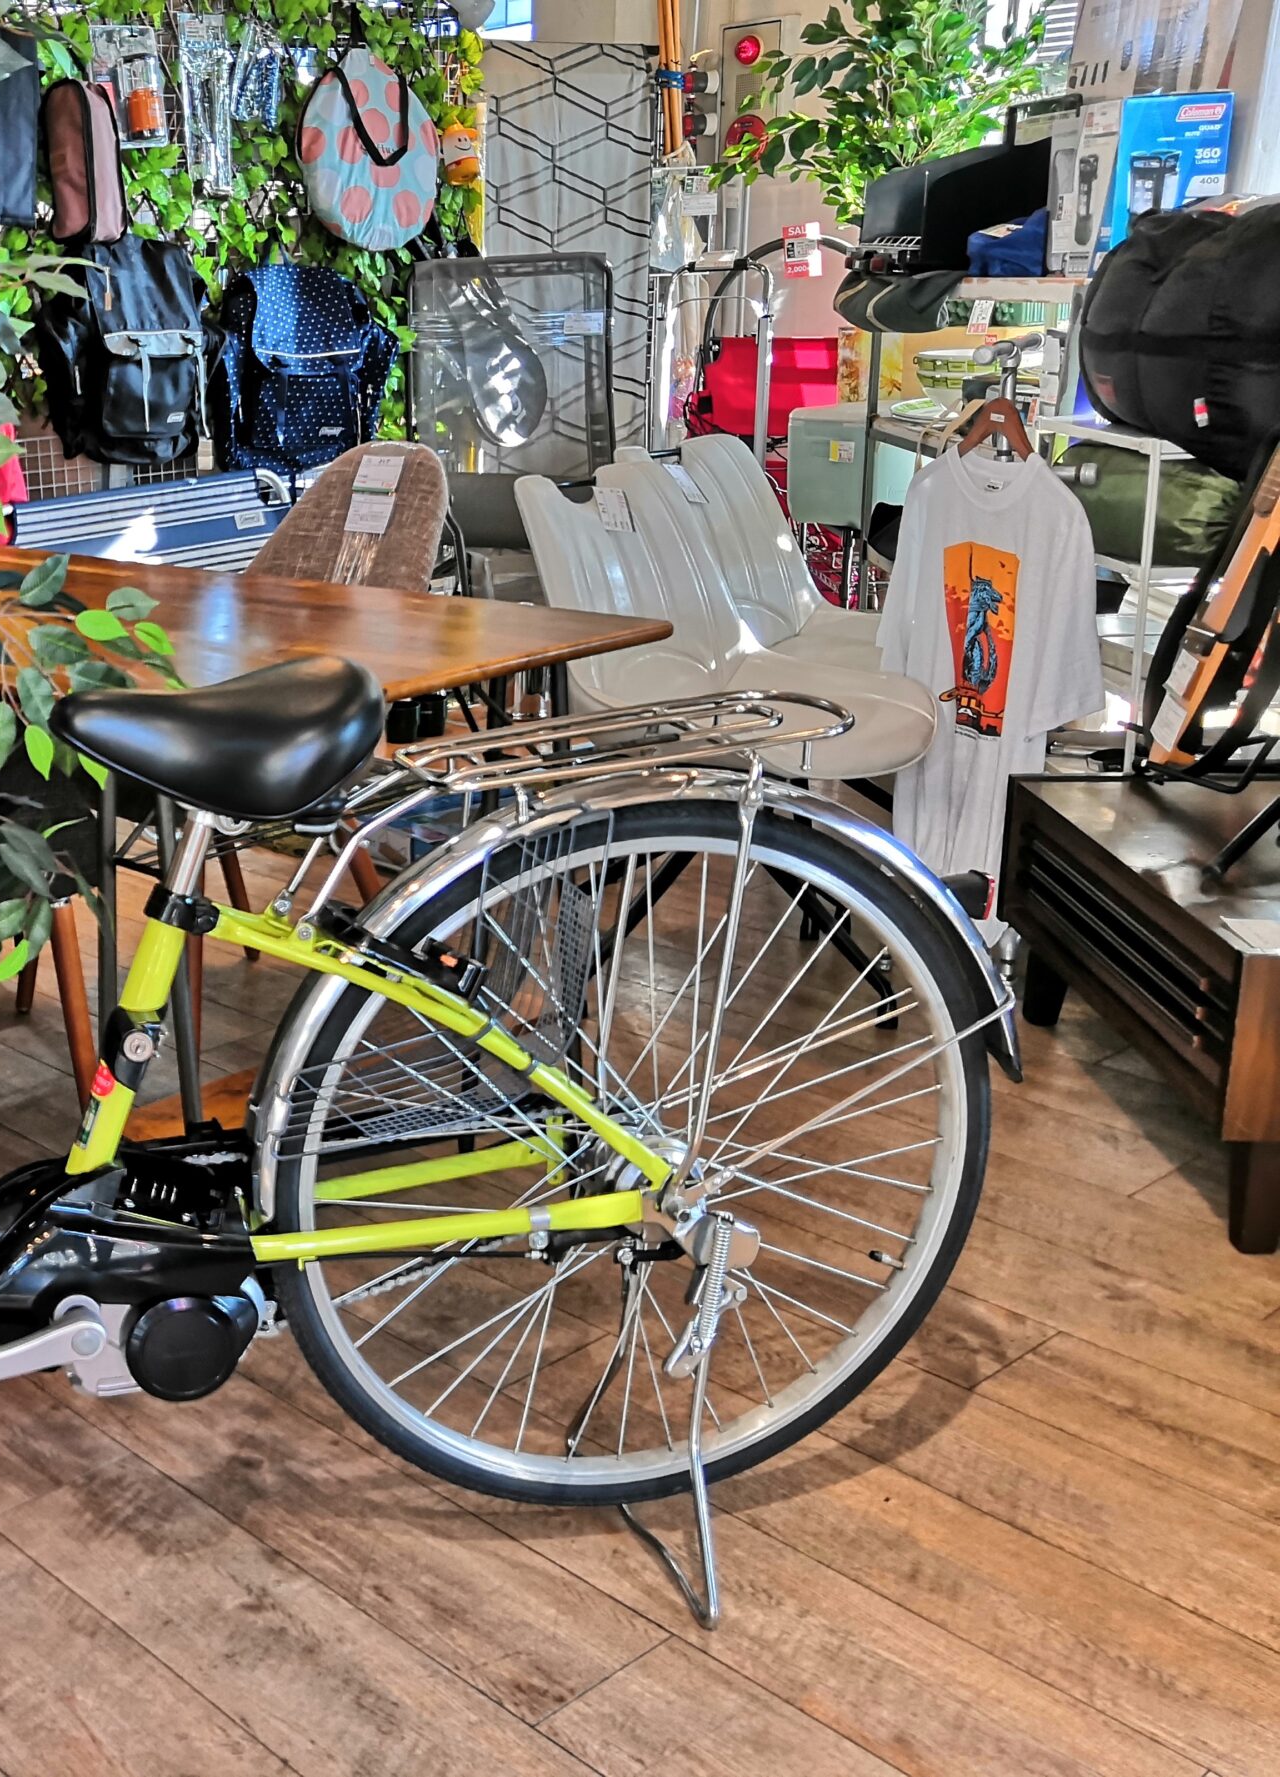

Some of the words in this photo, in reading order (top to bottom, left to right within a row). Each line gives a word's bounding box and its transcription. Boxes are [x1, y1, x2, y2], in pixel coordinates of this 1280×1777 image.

[1195, 148, 1221, 159] 360
[1200, 177, 1219, 185] 400
[788, 226, 807, 236] SAL
